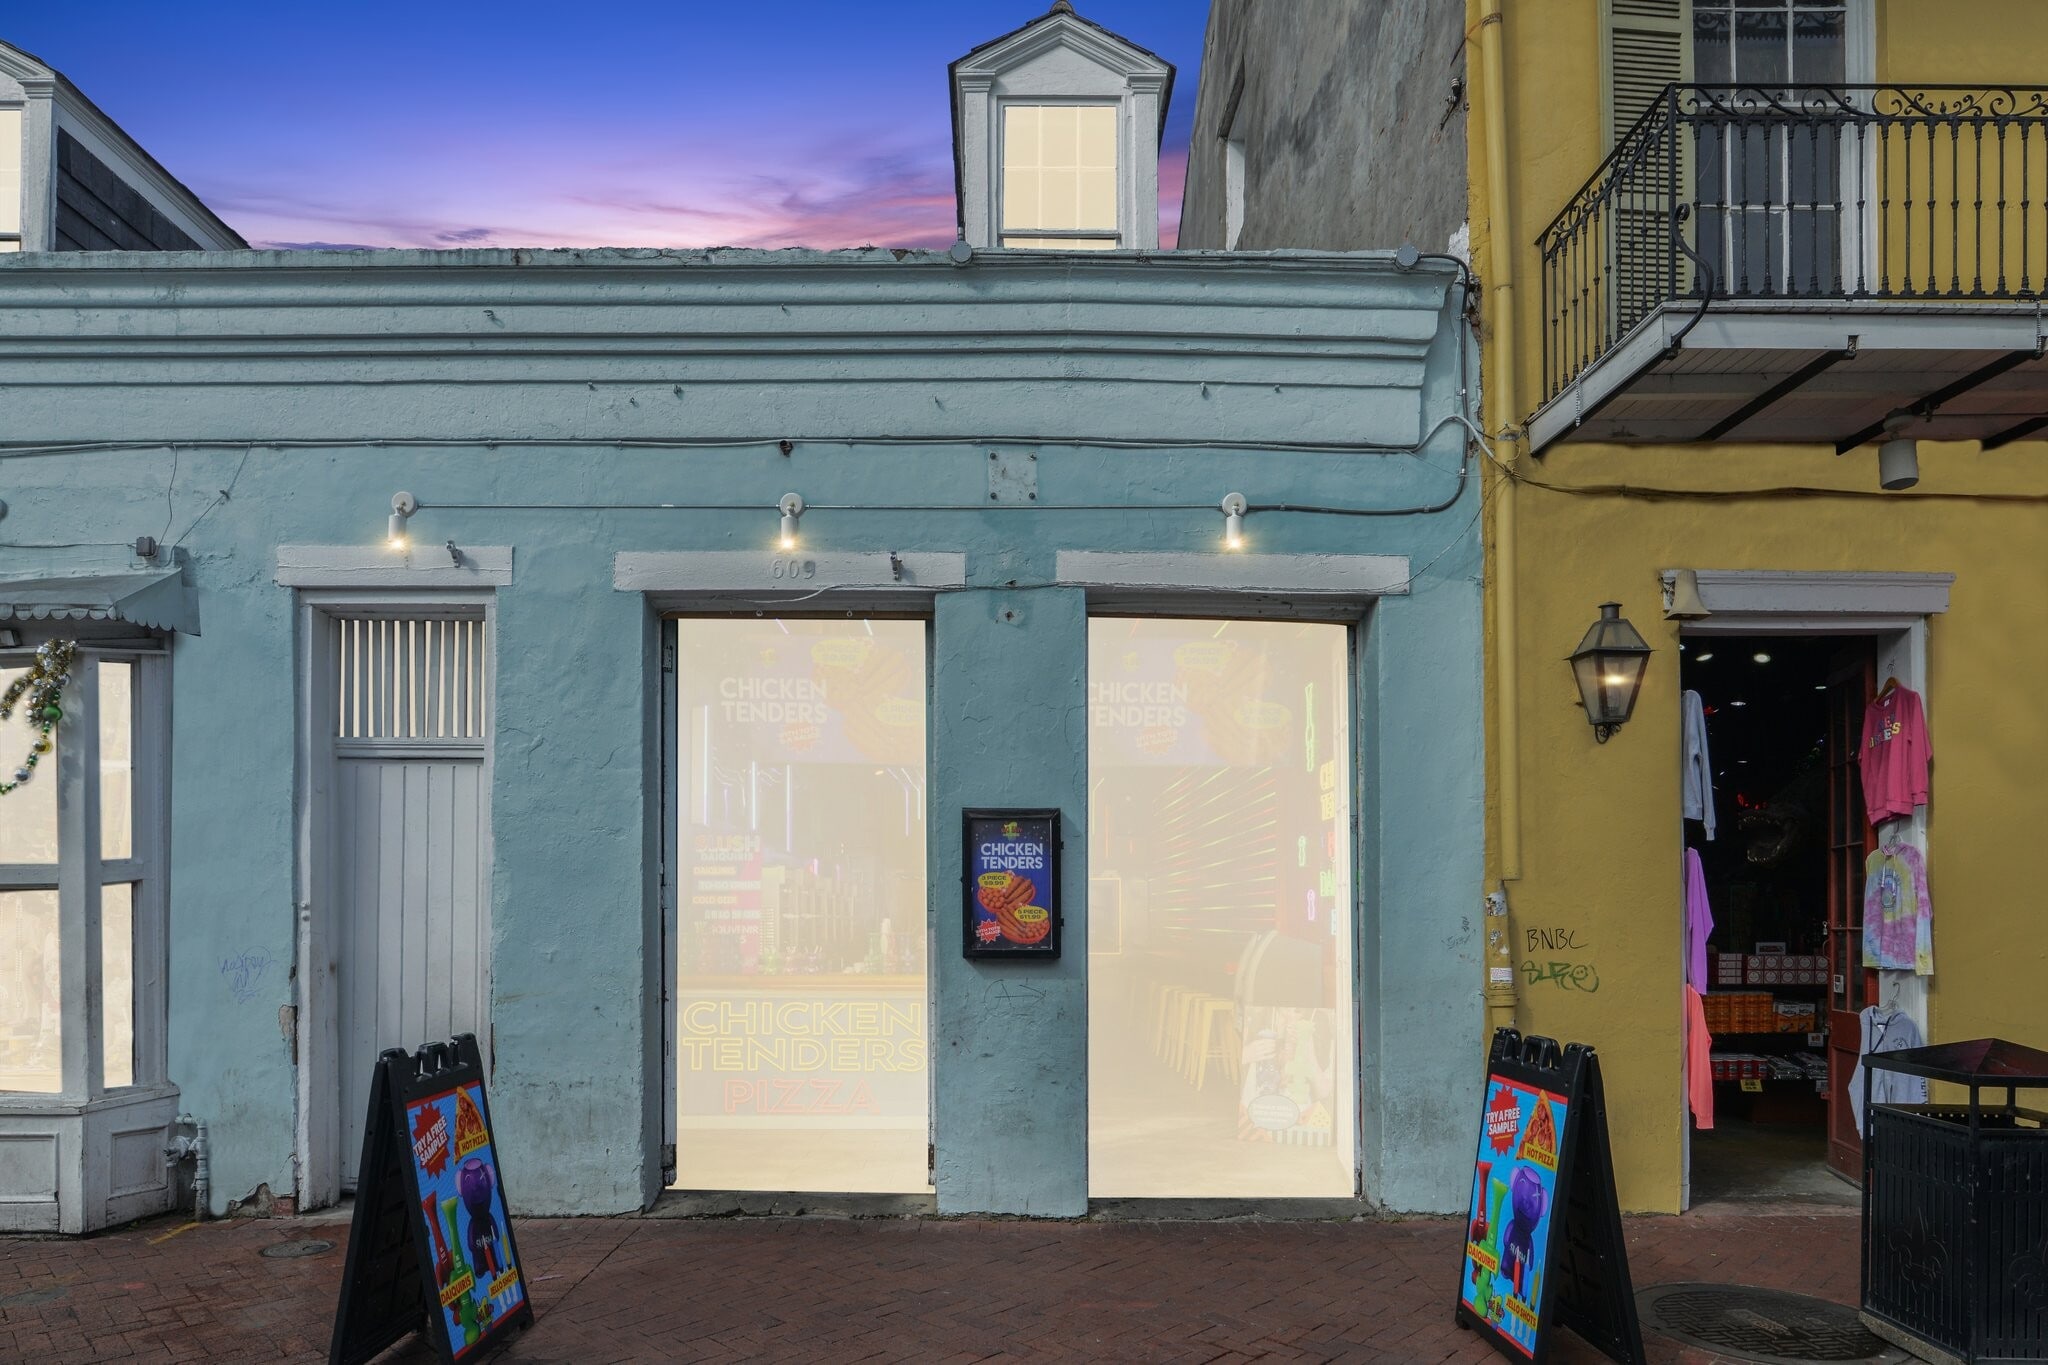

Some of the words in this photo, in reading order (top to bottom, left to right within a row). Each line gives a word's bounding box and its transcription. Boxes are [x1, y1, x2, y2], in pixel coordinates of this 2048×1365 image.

[770, 558, 817, 580] 609
[719, 676, 828, 700] CHICKEN
[720, 701, 828, 724] TENDERS
[980, 842, 1044, 856] CHICKEN
[980, 856, 1044, 870] TENDERS
[683, 1001, 922, 1036] CHICKEN
[682, 1036, 927, 1073] TENDERS
[723, 1078, 881, 1114] PIZZA
[1485, 1111, 1498, 1124] TRY
[1497, 1110, 1504, 1122] A
[1504, 1107, 1521, 1120] FREE
[1488, 1119, 1517, 1135] SAMPLE!
[412, 1135, 428, 1157] TRY
[430, 1115, 447, 1139] FREE
[462, 1140, 472, 1152] HOT
[472, 1134, 488, 1148] PIZZA
[419, 1130, 448, 1166] SAMPLE!
[1526, 1147, 1538, 1160] HOT
[1538, 1152, 1554, 1167] PIZZA
[1468, 1245, 1497, 1271] DAIQUIRIS
[440, 1275, 472, 1304] DAIQUIRIS
[502, 1271, 518, 1289] SHOTS
[1506, 1297, 1520, 1315] JELLO
[1519, 1306, 1537, 1327] SHOTS
